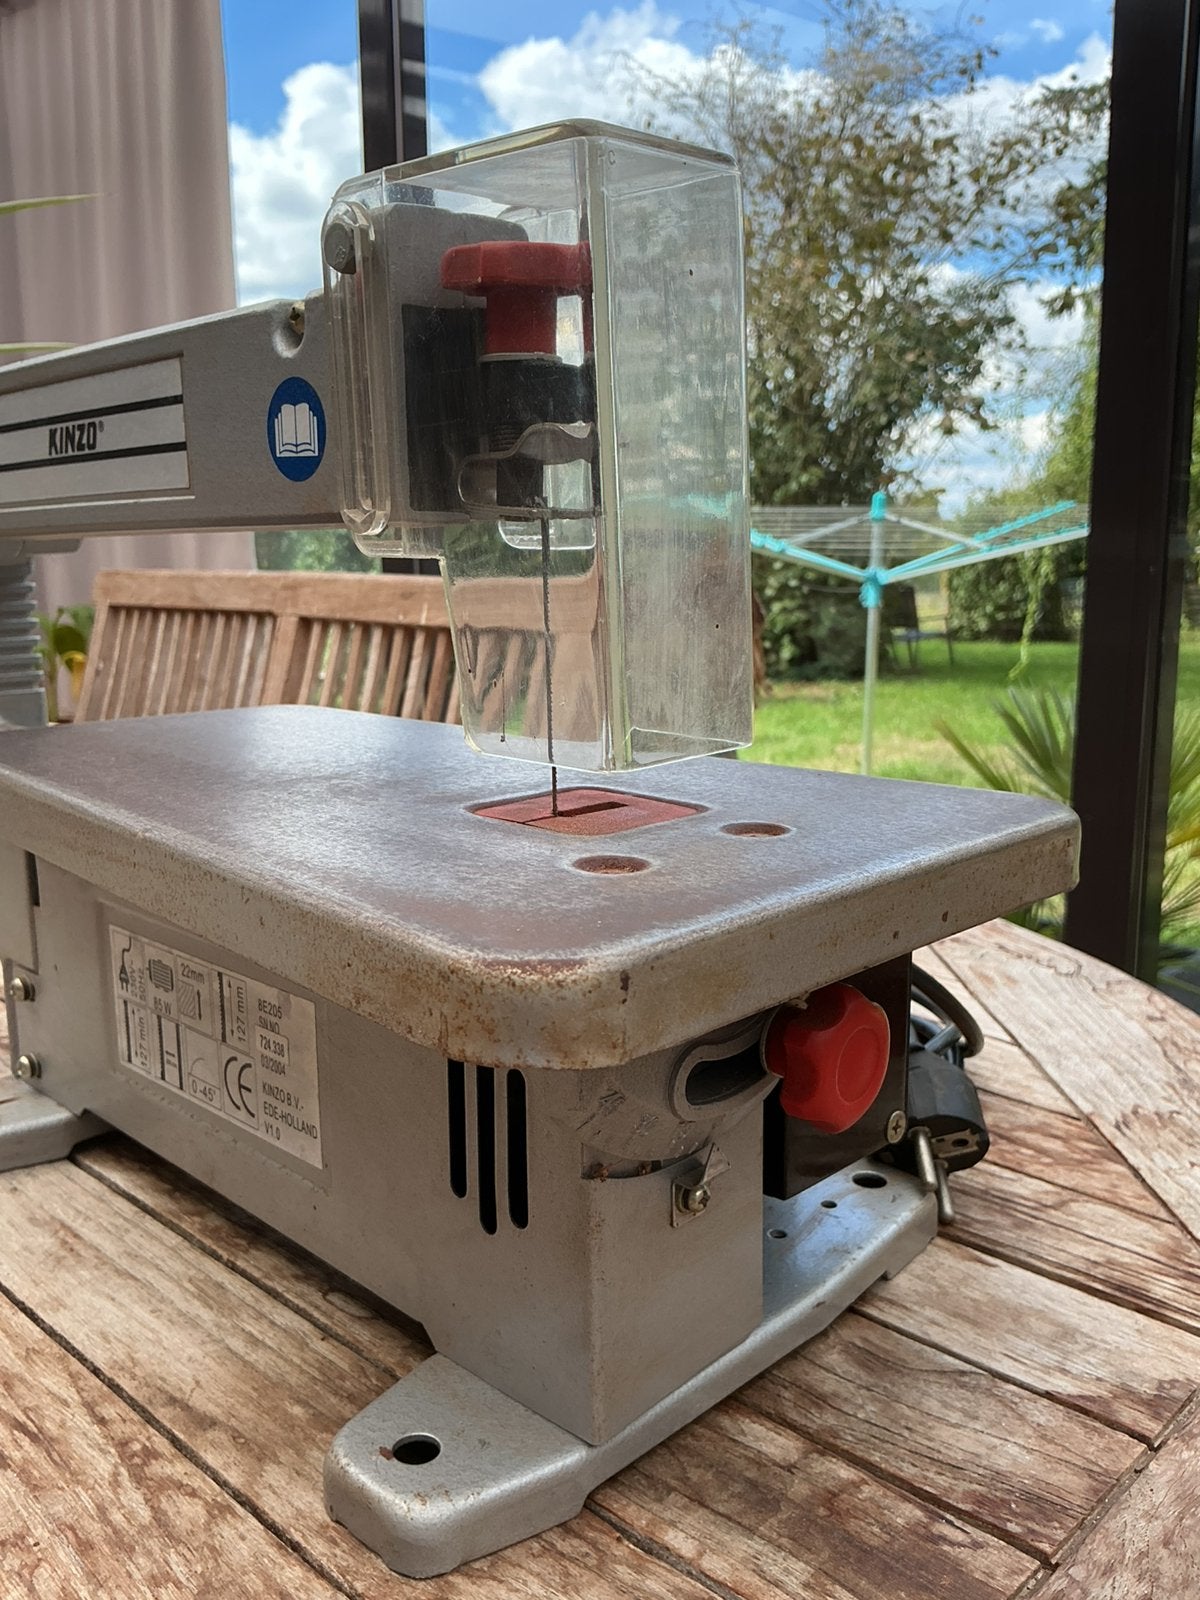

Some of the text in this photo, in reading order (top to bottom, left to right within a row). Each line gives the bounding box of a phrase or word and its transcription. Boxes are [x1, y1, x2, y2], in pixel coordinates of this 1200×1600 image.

[237, 1015, 246, 1042] 127
[262, 1081, 285, 1104] KINZO
[263, 1101, 318, 1139] EDE-HOLLAND
